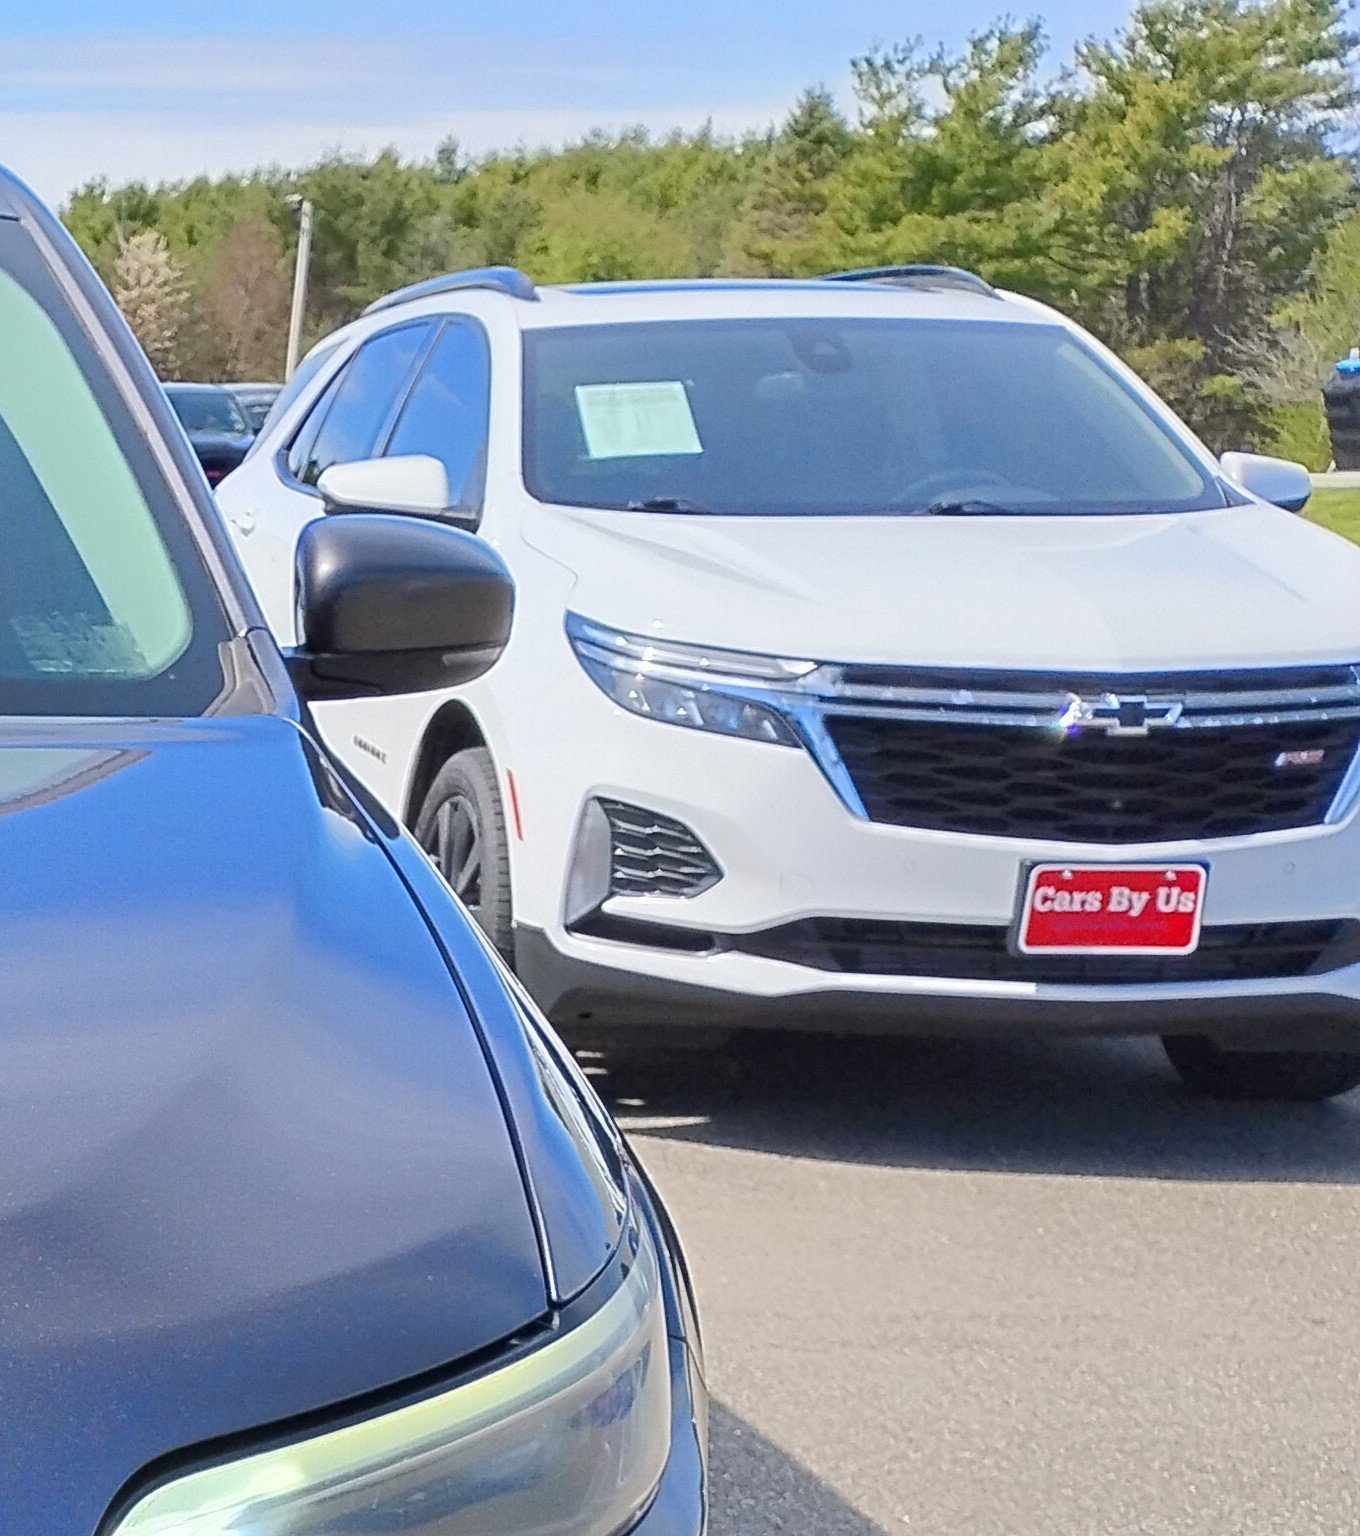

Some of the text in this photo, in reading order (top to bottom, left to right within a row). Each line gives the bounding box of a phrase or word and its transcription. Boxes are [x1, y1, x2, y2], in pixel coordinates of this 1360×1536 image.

[1033, 885, 1196, 917] Cars By Us
